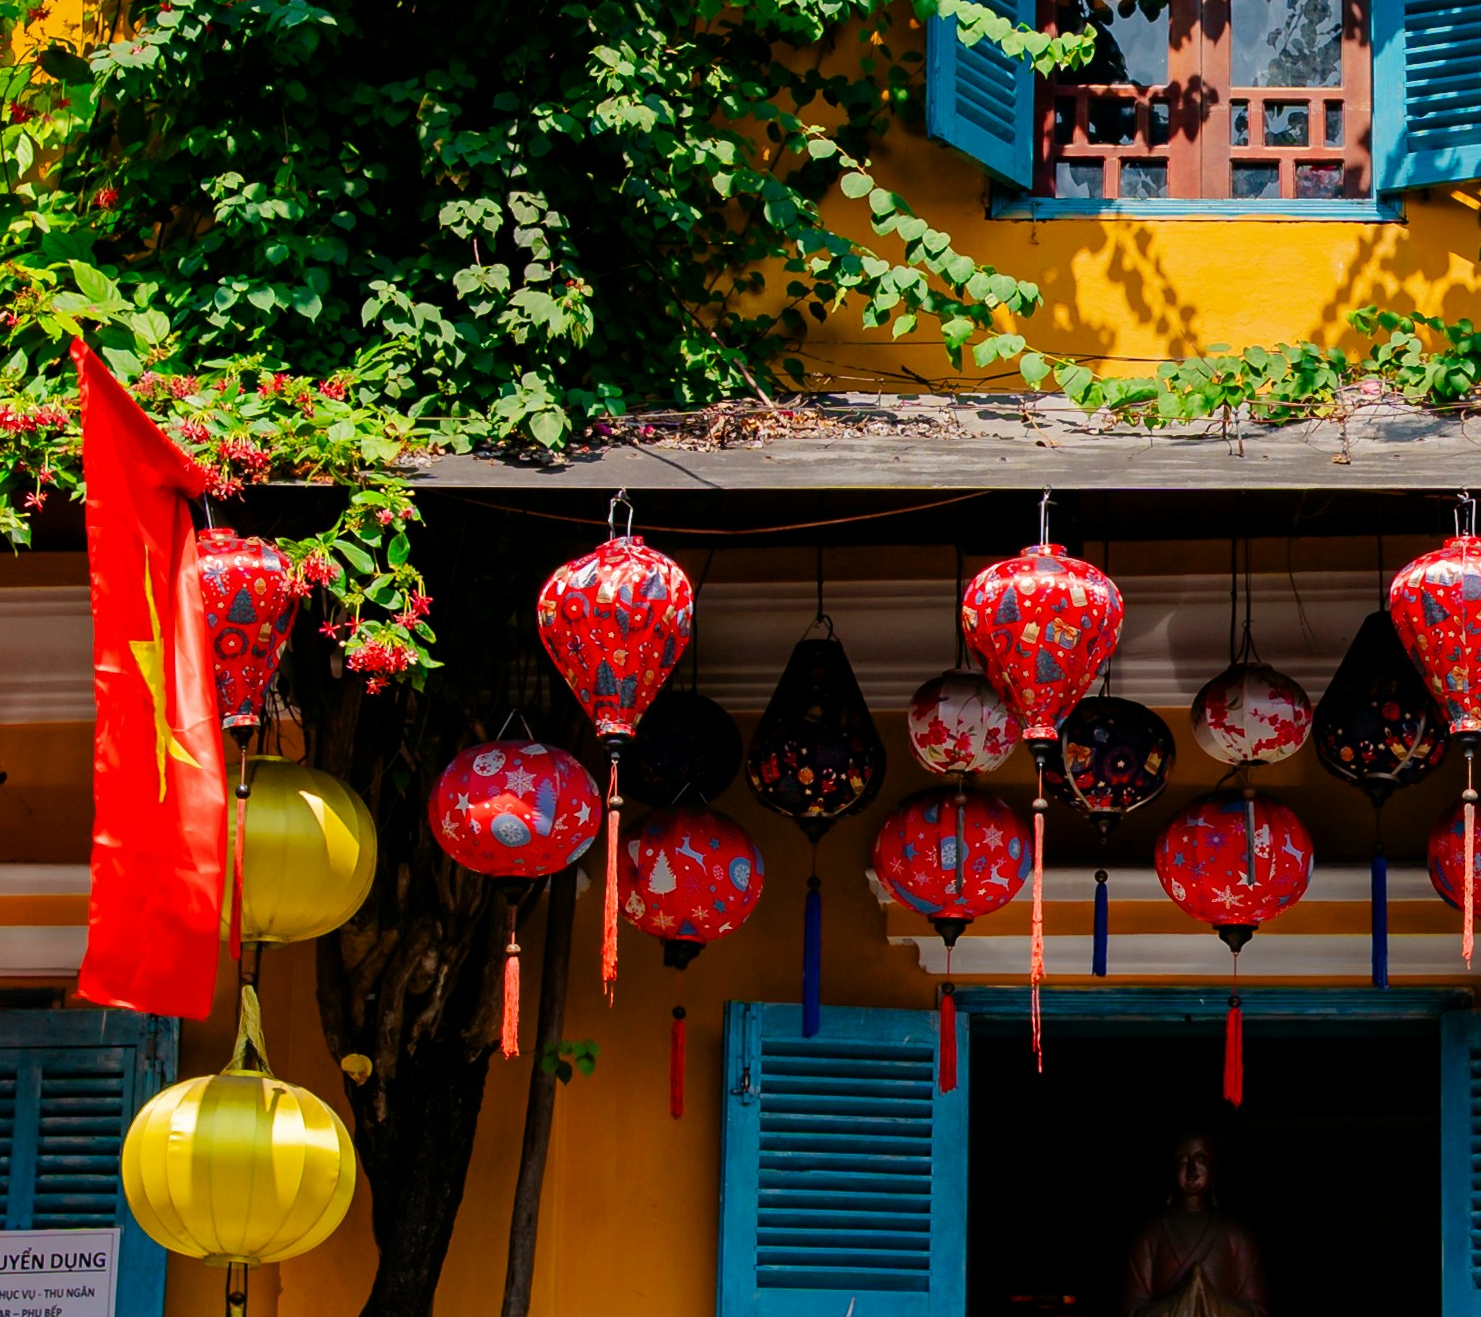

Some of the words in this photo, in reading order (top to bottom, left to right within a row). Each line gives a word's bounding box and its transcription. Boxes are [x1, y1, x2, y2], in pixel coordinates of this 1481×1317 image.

[50, 1252, 106, 1272] DỤNG
[21, 1290, 36, 1302] VỤ
[44, 1289, 64, 1299] THU
[66, 1285, 95, 1298] NGÂN
[44, 1304, 62, 1317] BẾP
